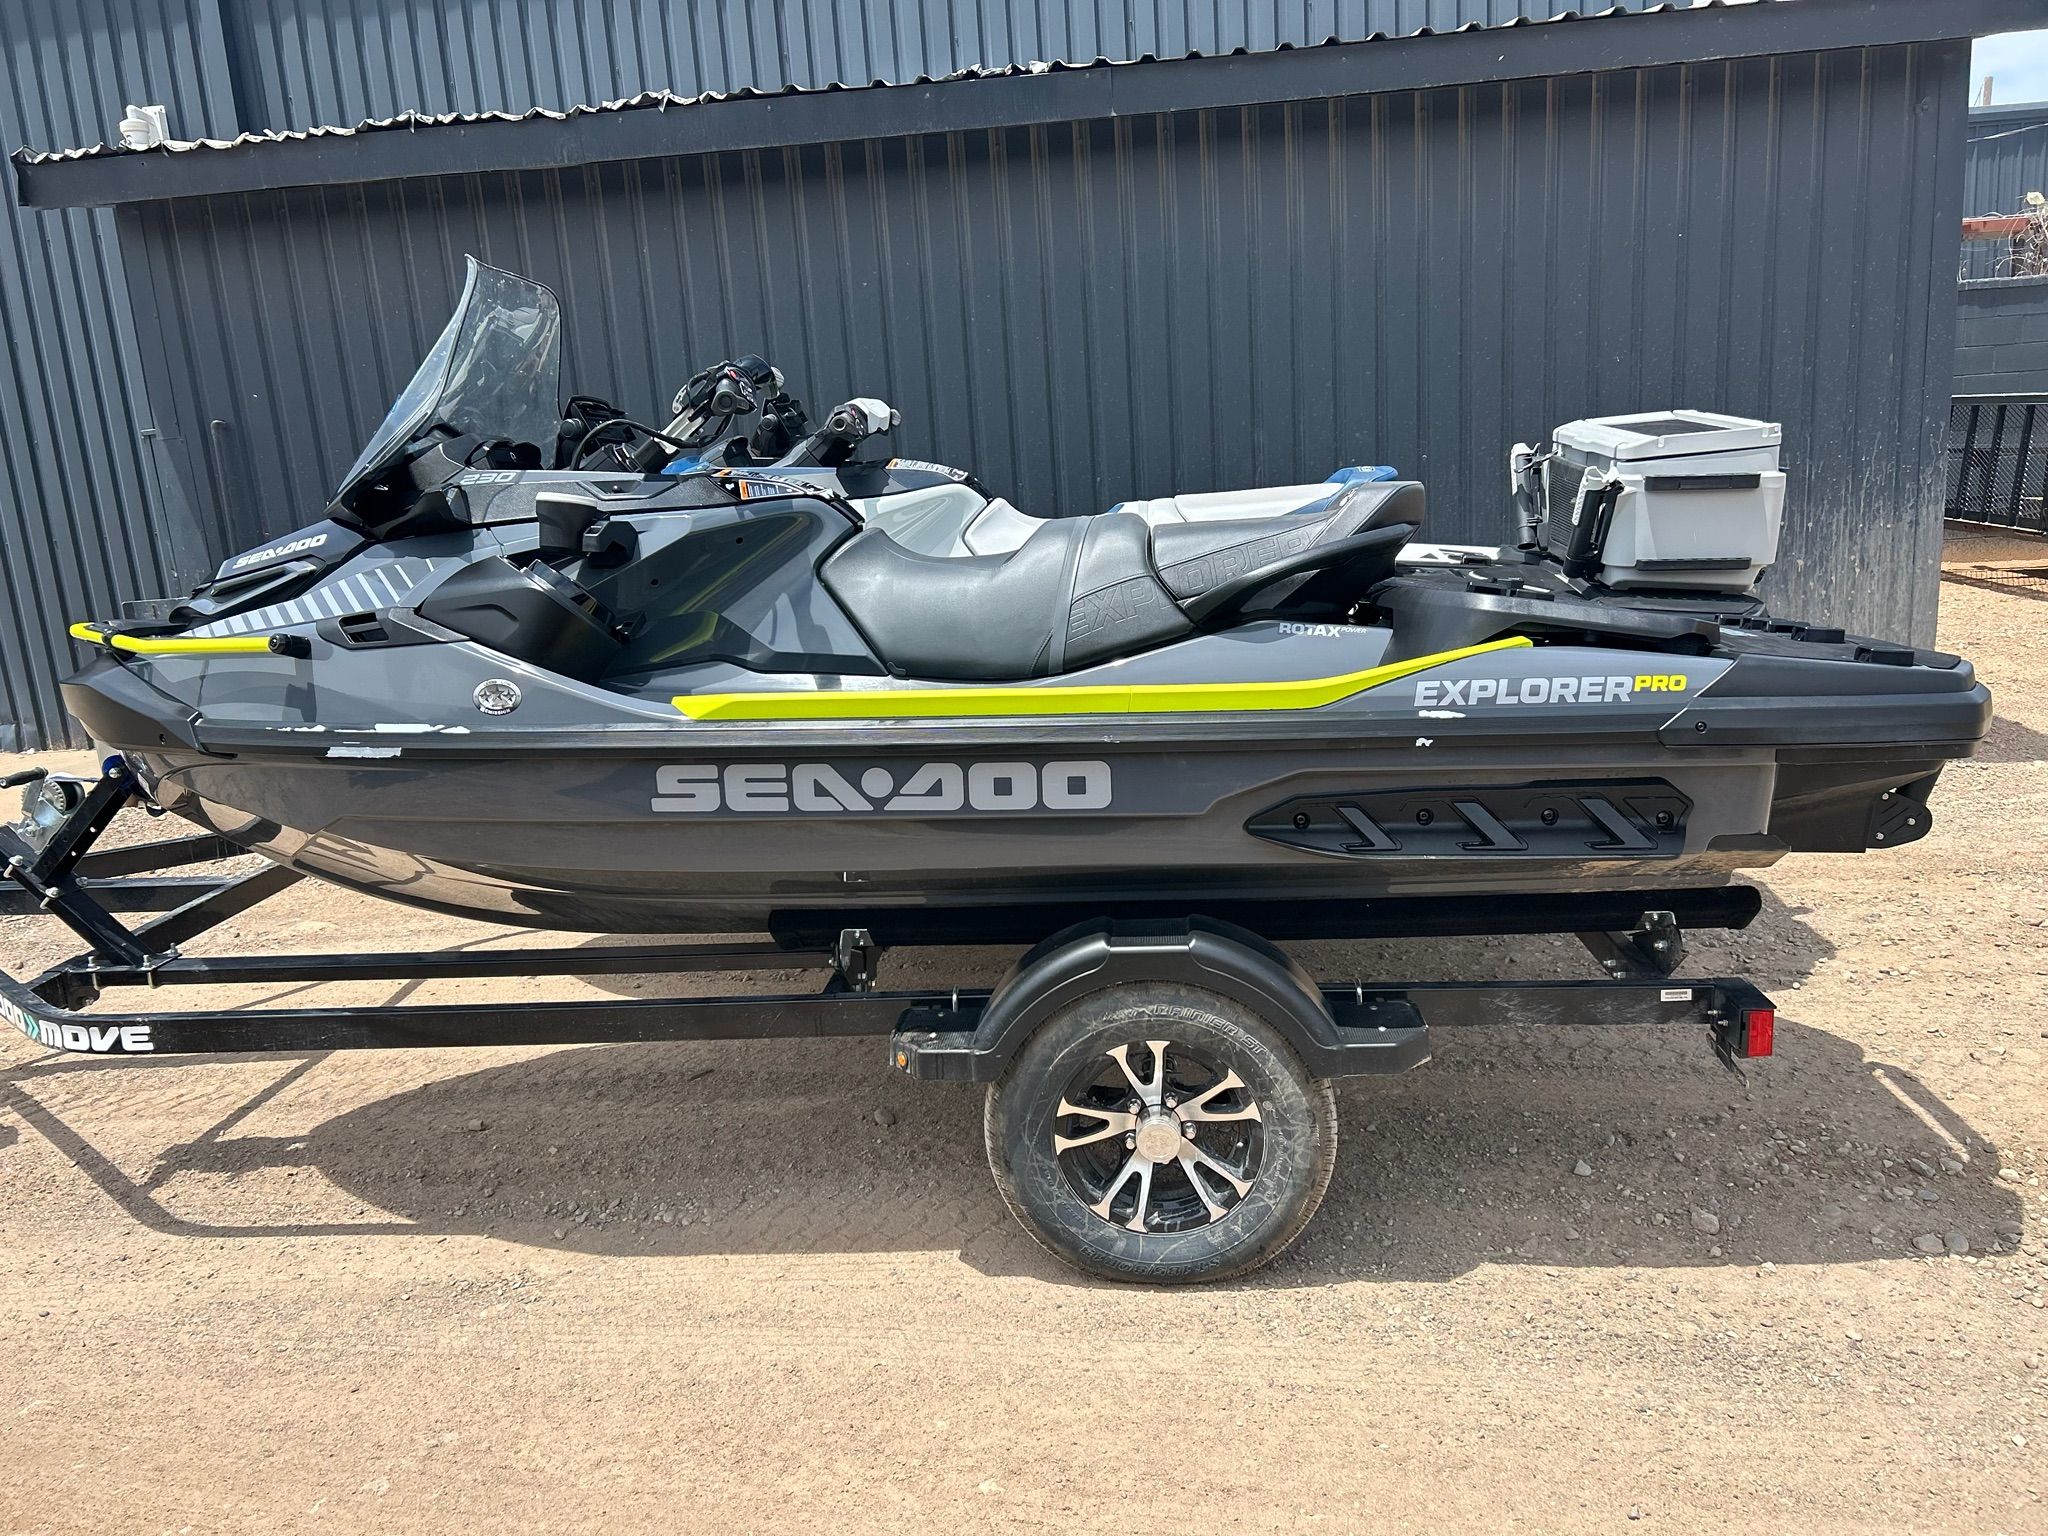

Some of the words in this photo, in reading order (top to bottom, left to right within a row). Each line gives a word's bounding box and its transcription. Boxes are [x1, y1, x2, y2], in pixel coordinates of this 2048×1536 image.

[459, 472, 517, 486] 230
[1278, 622, 1341, 638] ROTAX
[1341, 626, 1367, 634] POWER
[1413, 676, 1633, 707] EXPLORER
[1634, 674, 1687, 692] PRO
[38, 1019, 154, 1051] MOVE
[1153, 1003, 1238, 1036] RAINIER
